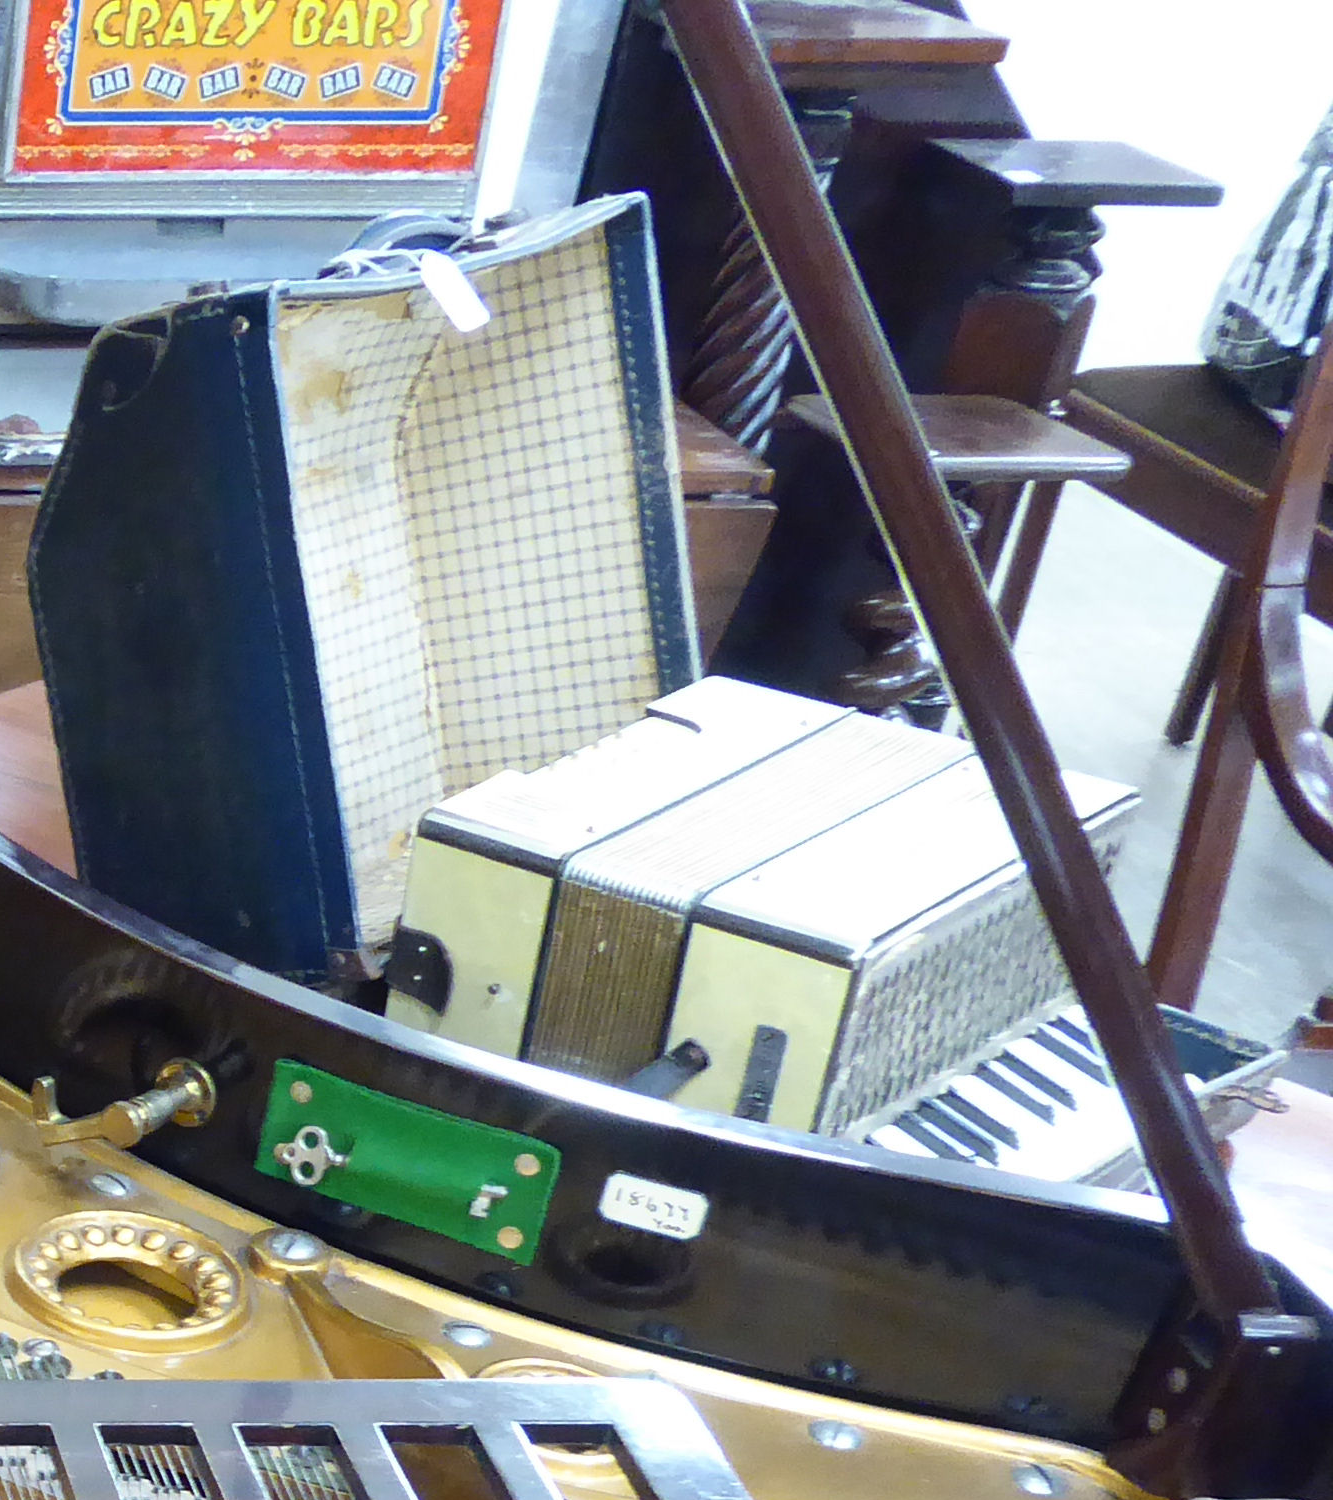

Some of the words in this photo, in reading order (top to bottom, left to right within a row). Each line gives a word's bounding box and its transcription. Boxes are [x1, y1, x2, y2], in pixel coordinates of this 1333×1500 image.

[92, 0, 277, 47] CRAZY
[291, 0, 431, 47] BARS
[91, 68, 127, 98] BAR
[146, 68, 182, 99] BAR
[201, 68, 237, 97] BAR
[267, 67, 302, 96] BAR
[322, 68, 357, 97] BAR
[376, 67, 412, 96] BAR
